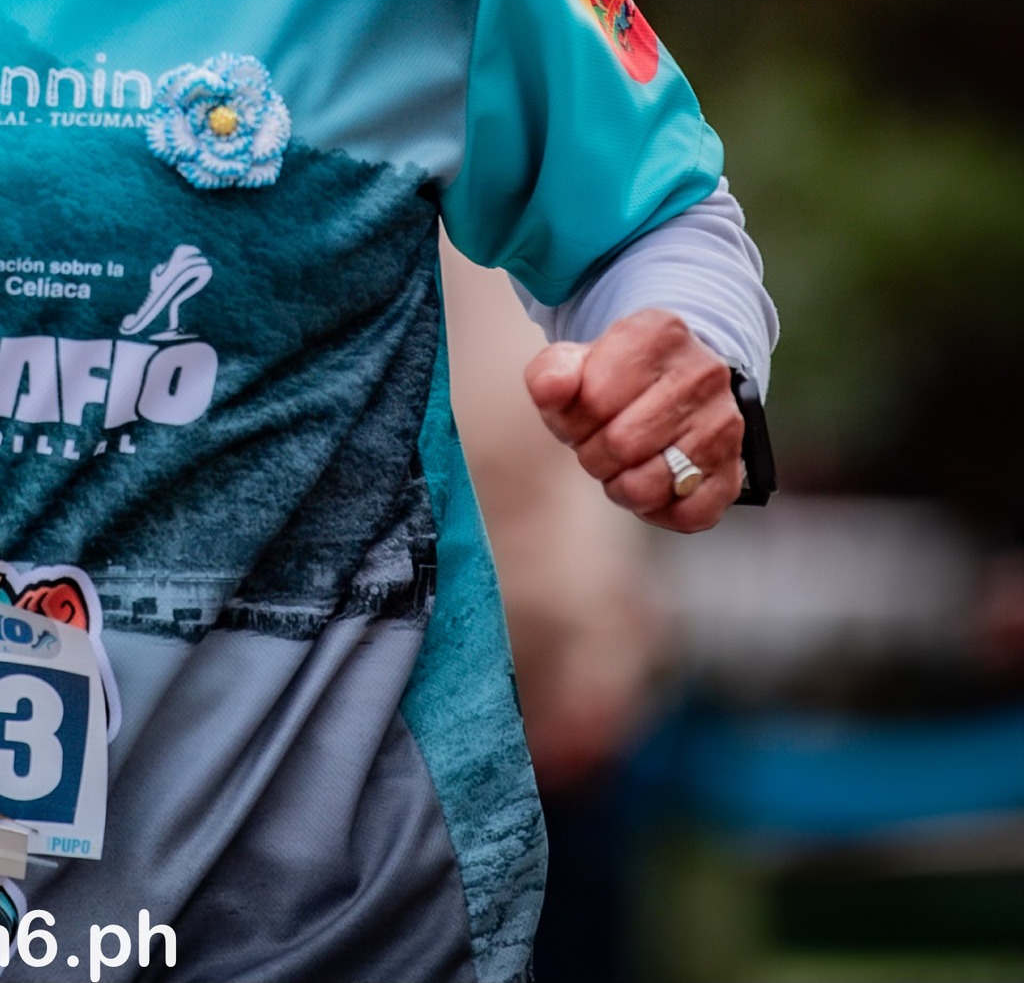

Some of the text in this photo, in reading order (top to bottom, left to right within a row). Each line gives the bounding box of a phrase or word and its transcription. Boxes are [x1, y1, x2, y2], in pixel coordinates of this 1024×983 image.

[49, 259, 103, 277] sobre
[106, 260, 125, 277] la
[5, 276, 92, 300] Celíaca
[50, 836, 92, 855] PUPO
